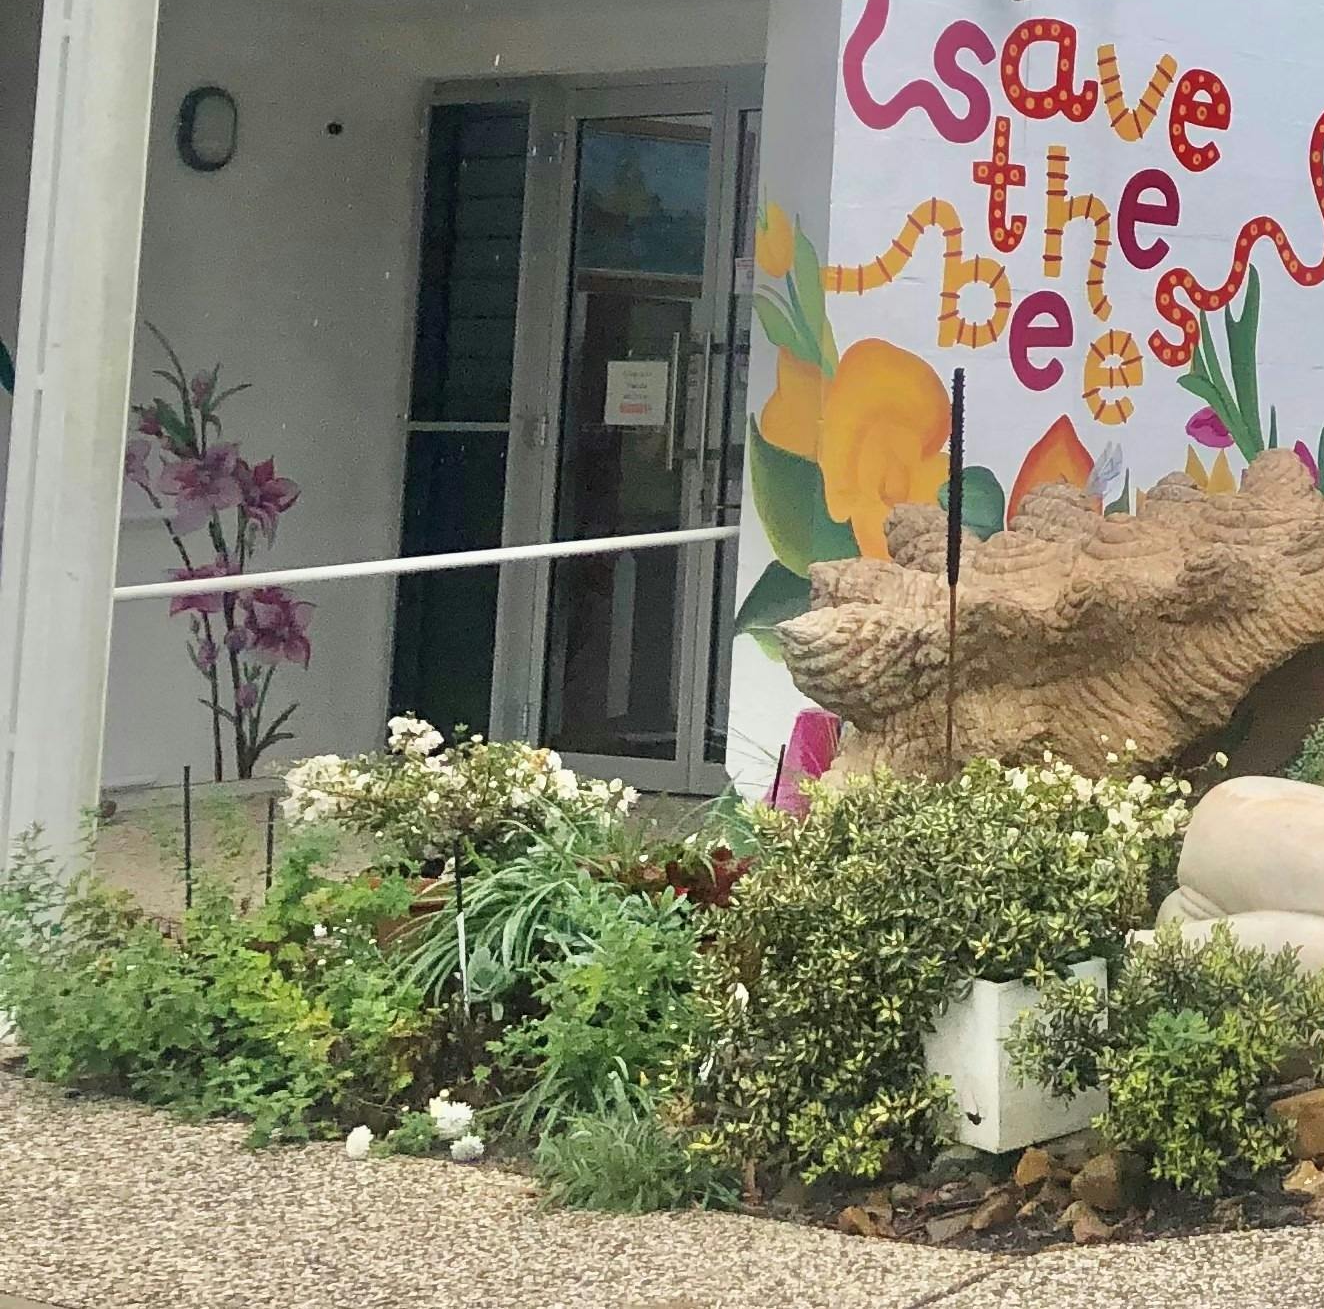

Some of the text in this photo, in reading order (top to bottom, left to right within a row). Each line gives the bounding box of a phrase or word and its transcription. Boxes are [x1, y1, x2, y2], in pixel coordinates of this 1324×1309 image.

[918, 17, 1232, 173] save
[935, 199, 1215, 426] bees
[973, 115, 1181, 323] the
